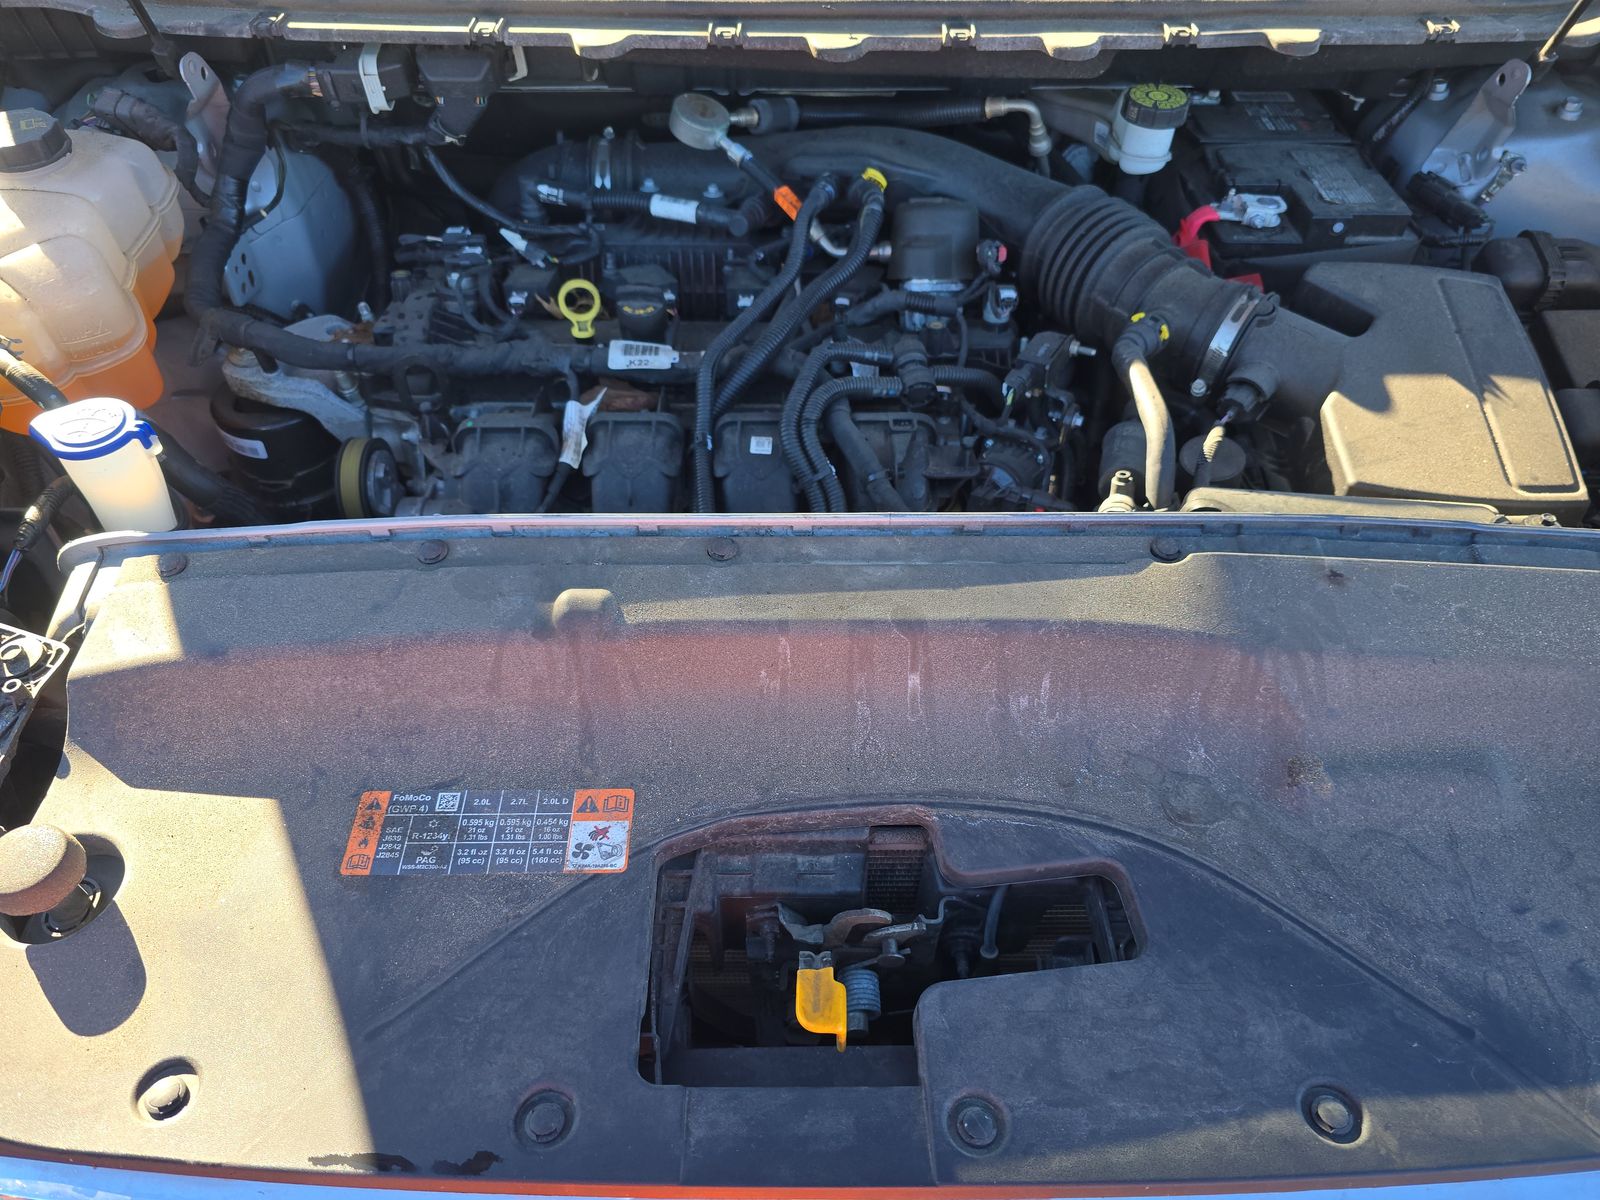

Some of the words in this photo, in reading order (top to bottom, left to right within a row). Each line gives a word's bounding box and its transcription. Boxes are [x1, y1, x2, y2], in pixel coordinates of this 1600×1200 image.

[393, 794, 431, 802] FoMoCo
[510, 798, 528, 806] 2.7L
[388, 805, 416, 813] (GWP
[418, 805, 429, 813] 4)
[484, 819, 495, 827] kg
[521, 819, 532, 827] kg
[558, 819, 569, 827] kg
[385, 826, 403, 834] SAE
[415, 856, 437, 864] PAG
[457, 857, 471, 865] (95
[471, 857, 485, 865] cc)
[495, 857, 509, 865] (95
[510, 857, 523, 865] cc)
[531, 856, 549, 864] (160
[550, 856, 563, 864] cc)
